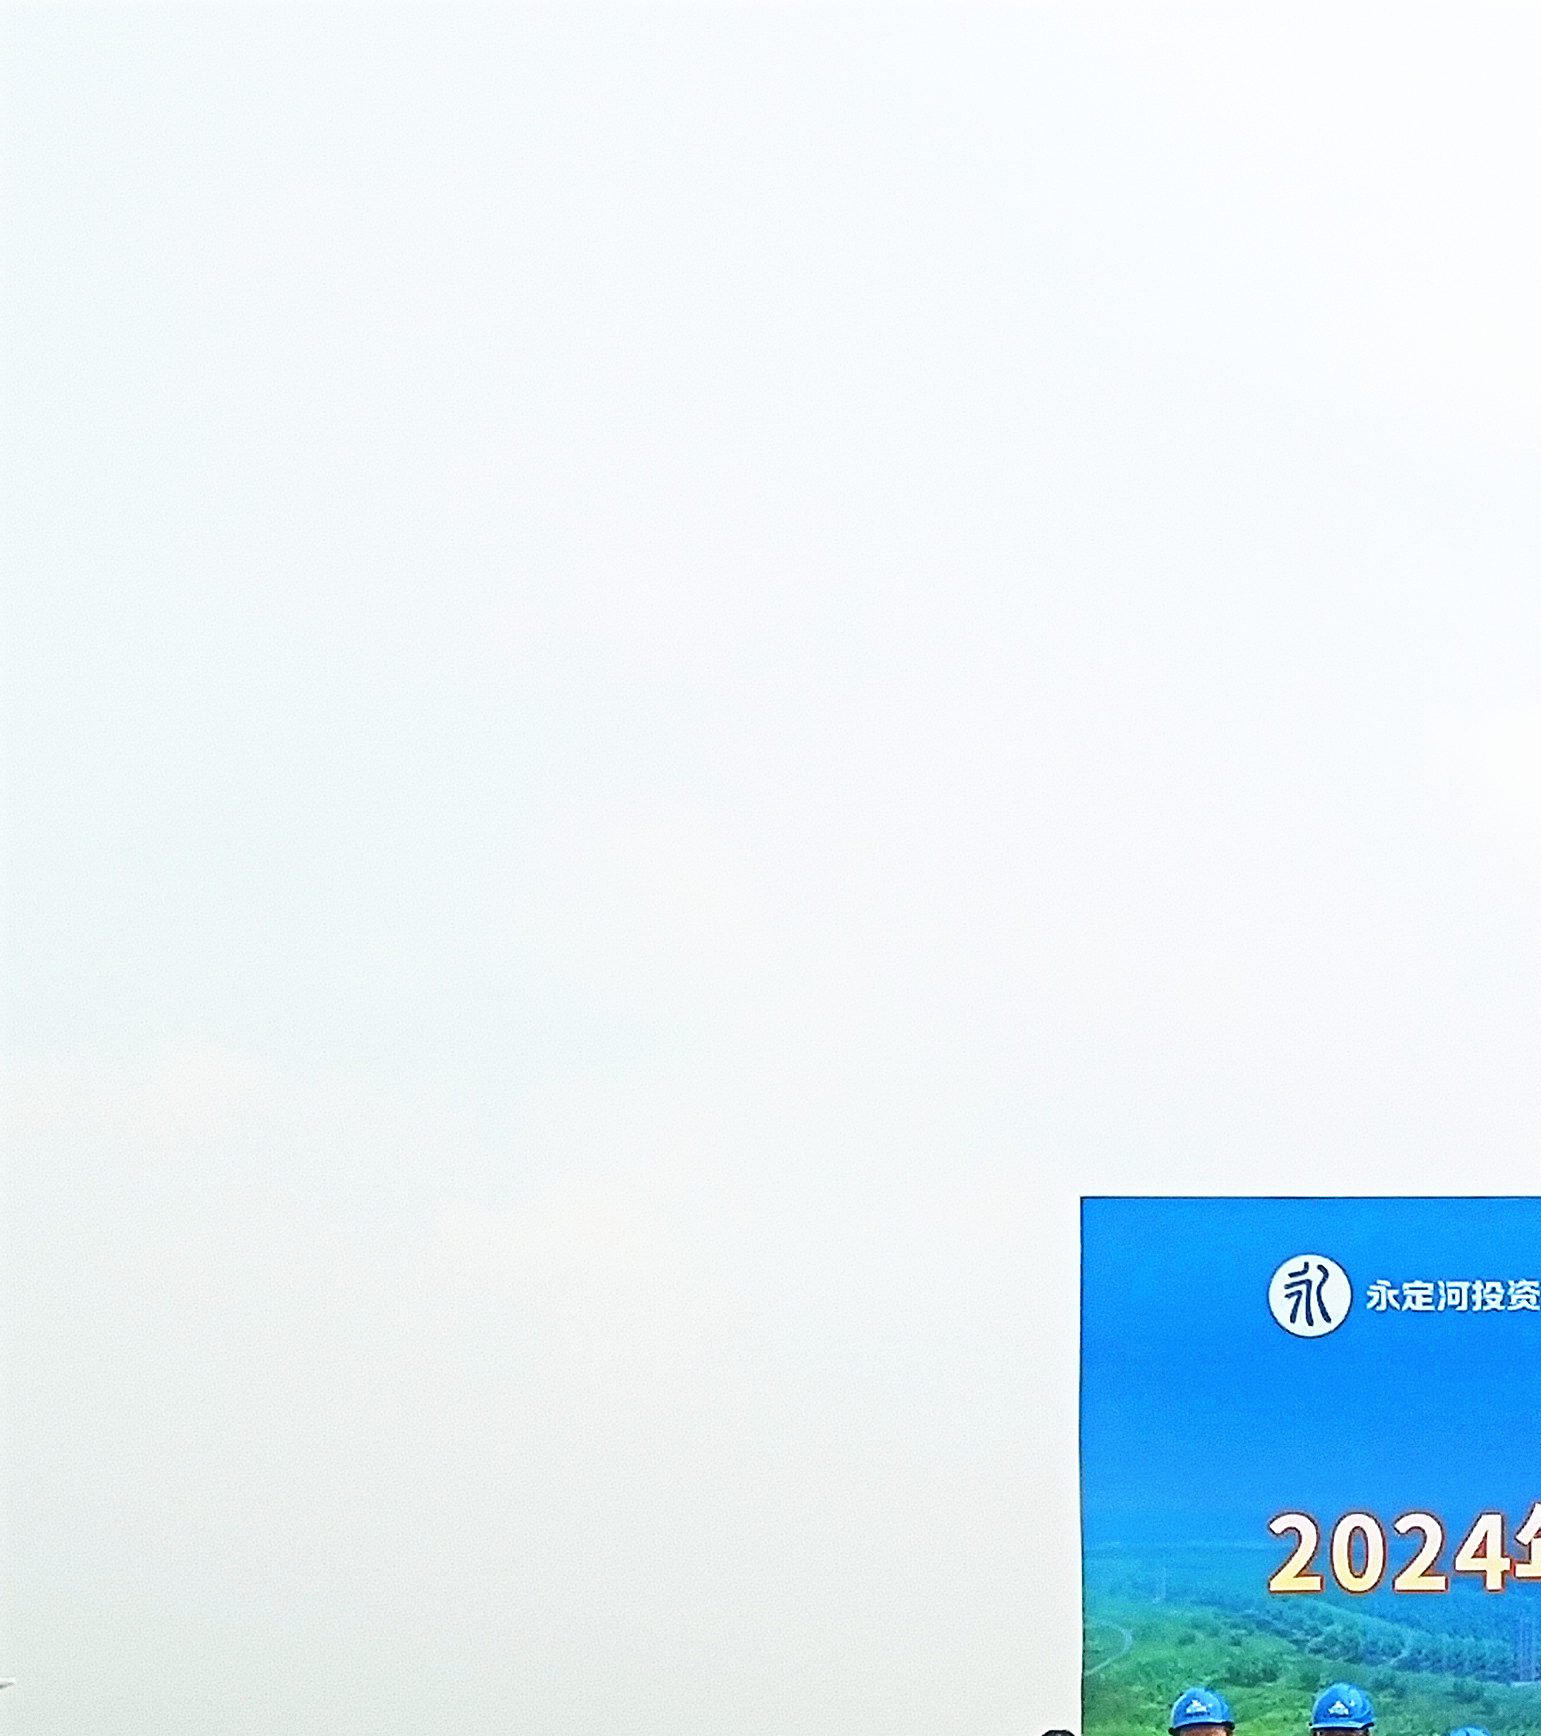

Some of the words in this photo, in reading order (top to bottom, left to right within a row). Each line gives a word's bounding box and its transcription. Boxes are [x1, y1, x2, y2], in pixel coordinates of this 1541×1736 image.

[1366, 1279, 1541, 1314] 永定河投资
